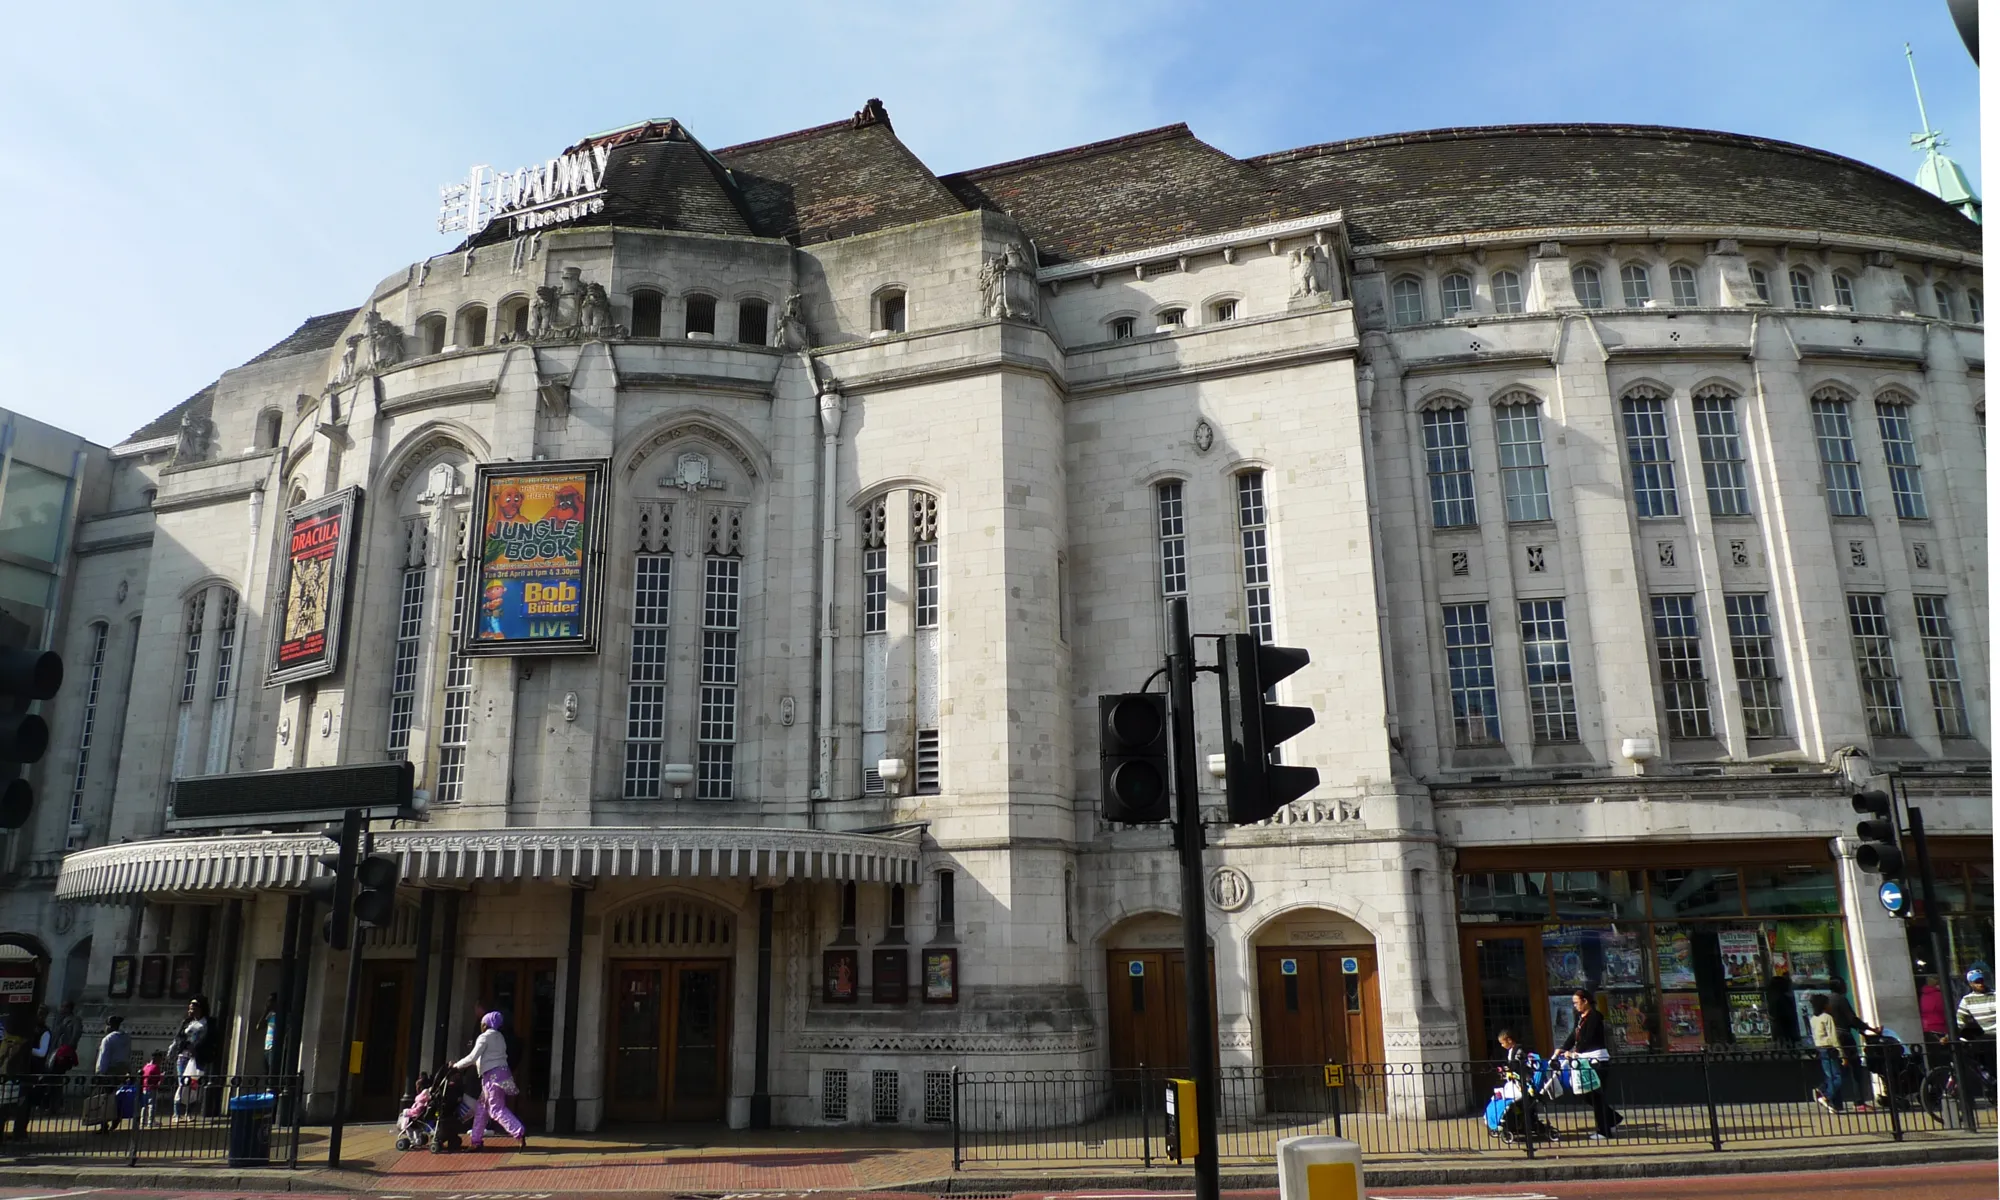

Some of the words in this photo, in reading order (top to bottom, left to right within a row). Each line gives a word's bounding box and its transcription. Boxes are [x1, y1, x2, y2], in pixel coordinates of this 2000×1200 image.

[470, 143, 612, 235] BROADWAY
[292, 521, 338, 553] DRACULA
[489, 516, 580, 541] JUNGLE
[504, 537, 577, 561] BOOK
[509, 570, 525, 578] April
[535, 569, 547, 577] 1pm
[555, 568, 580, 576] 3.30pm
[525, 581, 576, 603] Bob
[528, 602, 578, 614] Builder
[529, 620, 570, 638] LIVE
